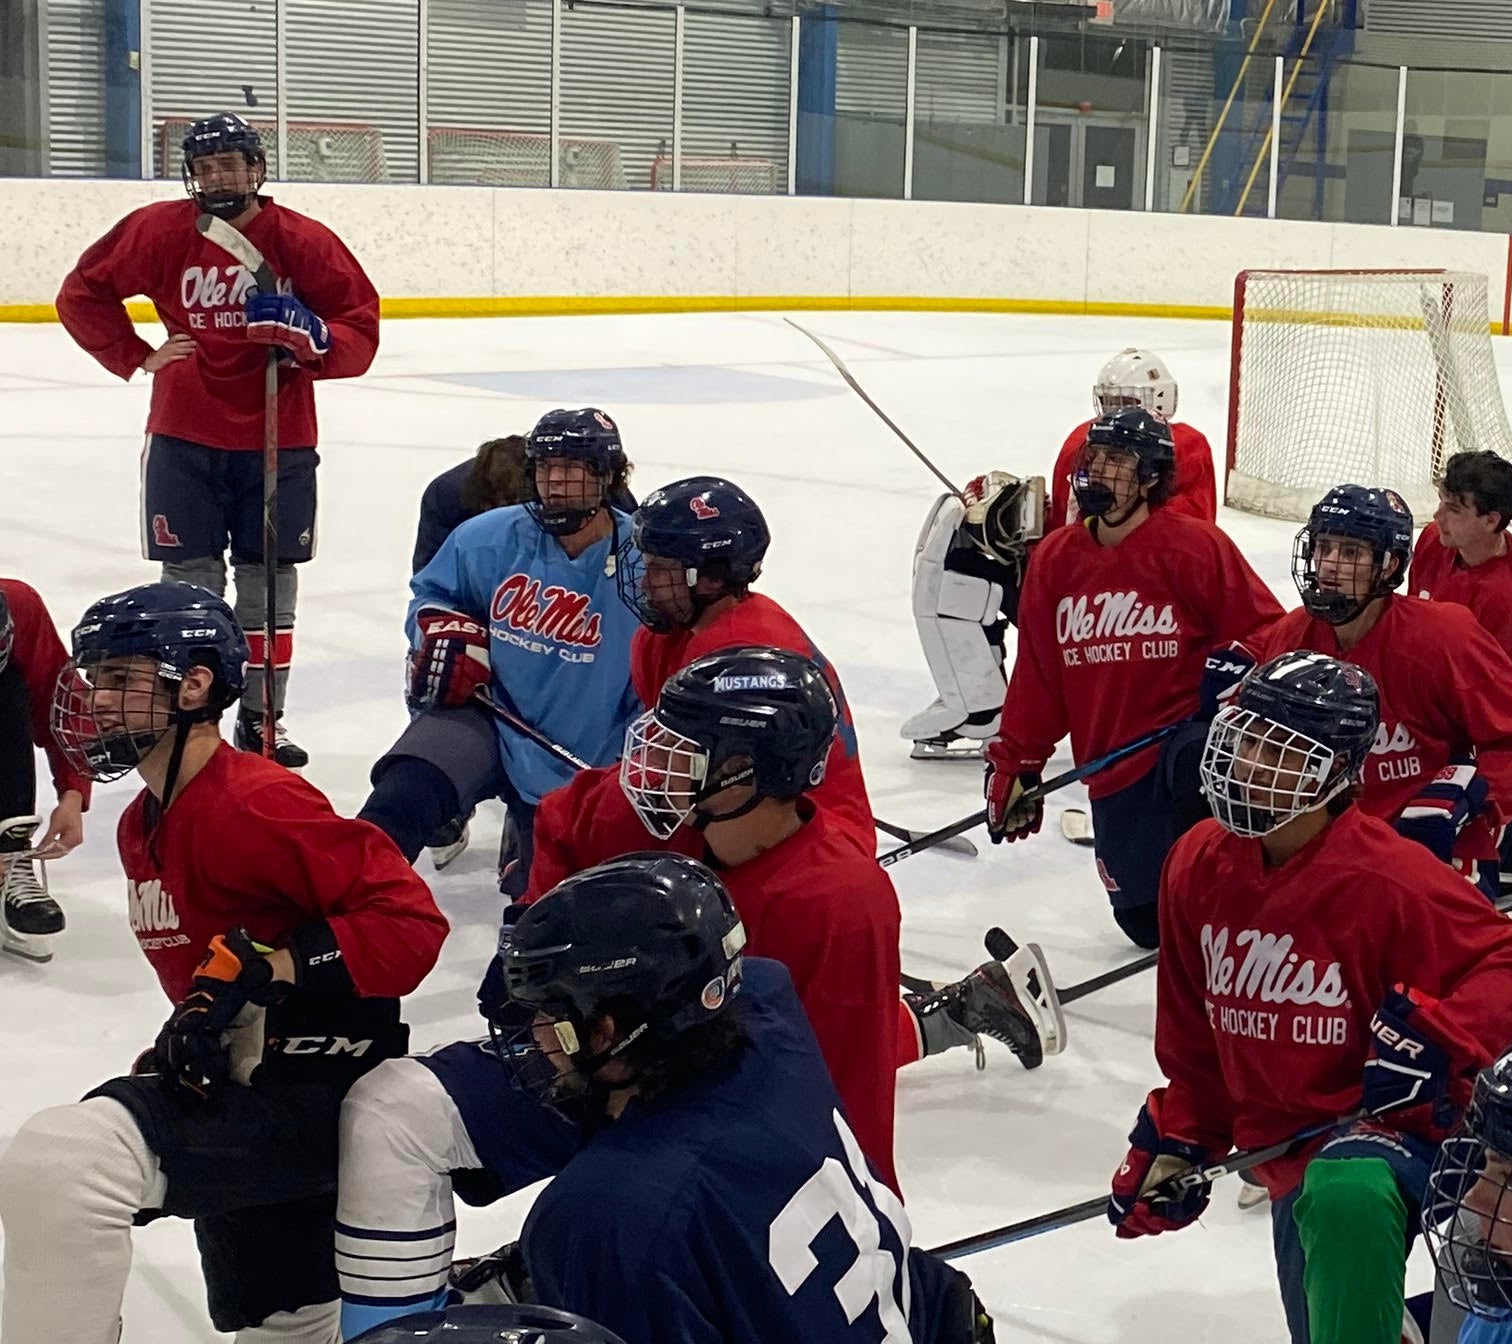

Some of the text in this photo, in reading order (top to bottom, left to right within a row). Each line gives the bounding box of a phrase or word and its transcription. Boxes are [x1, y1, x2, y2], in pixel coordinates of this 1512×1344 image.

[180, 265, 227, 309] Ole
[1320, 504, 1351, 516] CCM
[701, 538, 732, 550] CCM
[489, 573, 542, 632] Ole
[425, 619, 490, 639] EAST
[1055, 589, 1182, 645] Ole Miss
[180, 628, 217, 639] CCM
[1062, 639, 1179, 668] ICE HOCKEY CLUB
[1204, 656, 1247, 675] CM
[713, 674, 788, 694] MUSTANGS
[1370, 720, 1418, 755] ss
[720, 766, 755, 790] BAUER
[1378, 756, 1422, 783] CLUB
[1233, 928, 1350, 1008] Miss
[1219, 1004, 1348, 1045] HOCKEY CLUB
[1368, 1009, 1426, 1061] UER
[282, 1035, 374, 1057] CM
